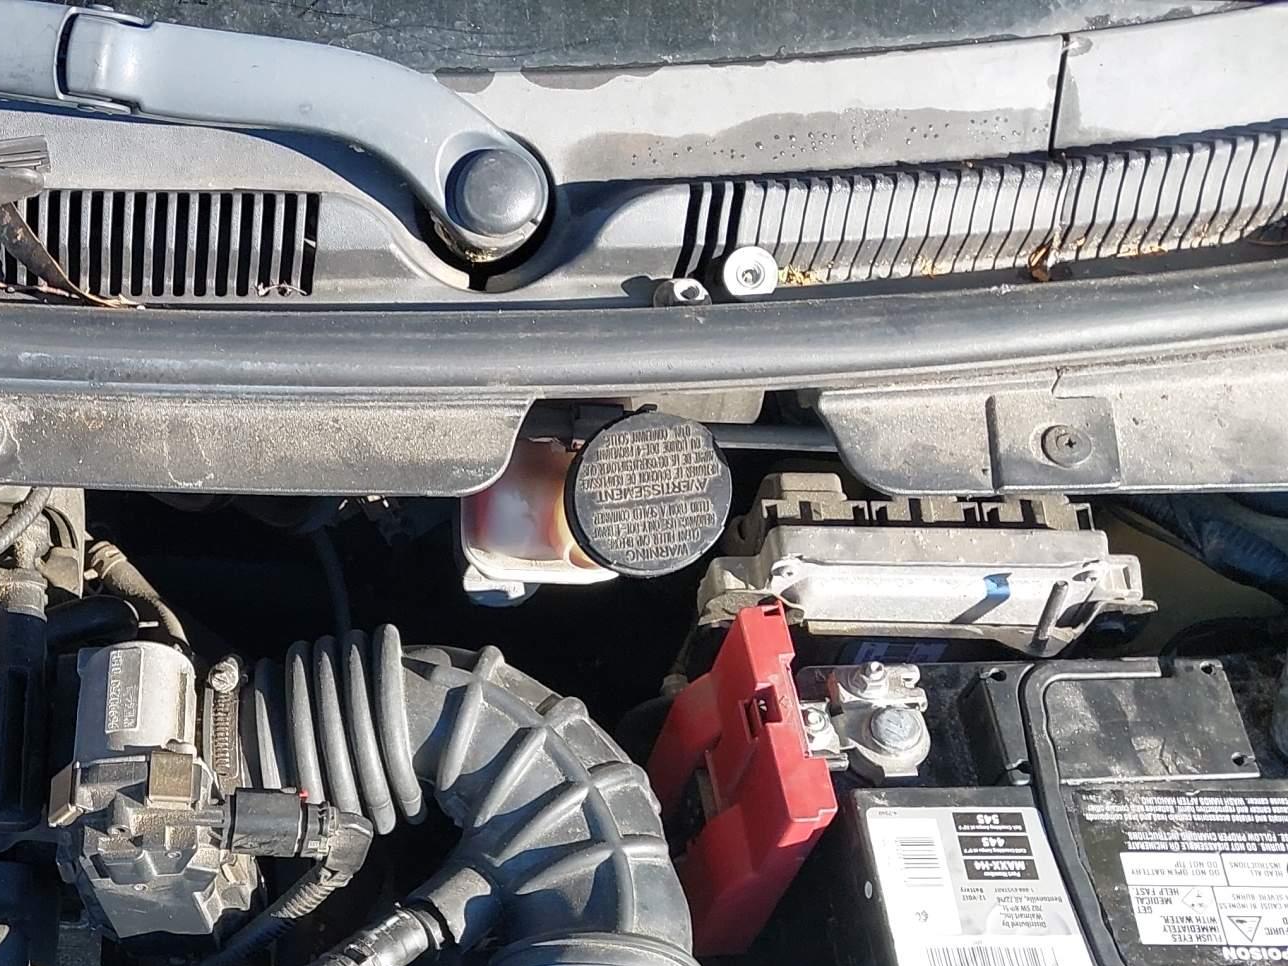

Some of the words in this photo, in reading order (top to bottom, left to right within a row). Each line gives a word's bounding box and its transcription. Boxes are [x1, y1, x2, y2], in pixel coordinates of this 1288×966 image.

[596, 478, 707, 503] AVERTISSEMENT
[626, 544, 689, 562] WARNING
[1176, 797, 1198, 805] AFTER
[976, 814, 1000, 824] 545
[1218, 832, 1246, 842] PROPER
[1246, 832, 1277, 842] FOLLOW
[982, 837, 1005, 847] 445
[1181, 841, 1230, 851] DISASSEMBLE
[1230, 841, 1245, 851] NOT
[974, 861, 1026, 870] MAXX-H4
[1131, 868, 1164, 876] BATTERY
[1159, 888, 1179, 896] HELP
[1135, 897, 1172, 905] MEDICAL
[1002, 920, 1010, 928] by
[1160, 915, 1192, 924] WATER.
[1195, 916, 1216, 924] WITH
[1162, 925, 1219, 933] IMMEDIATELY
[1171, 934, 1193, 942] EYES
[1196, 934, 1222, 942] FLUSH
